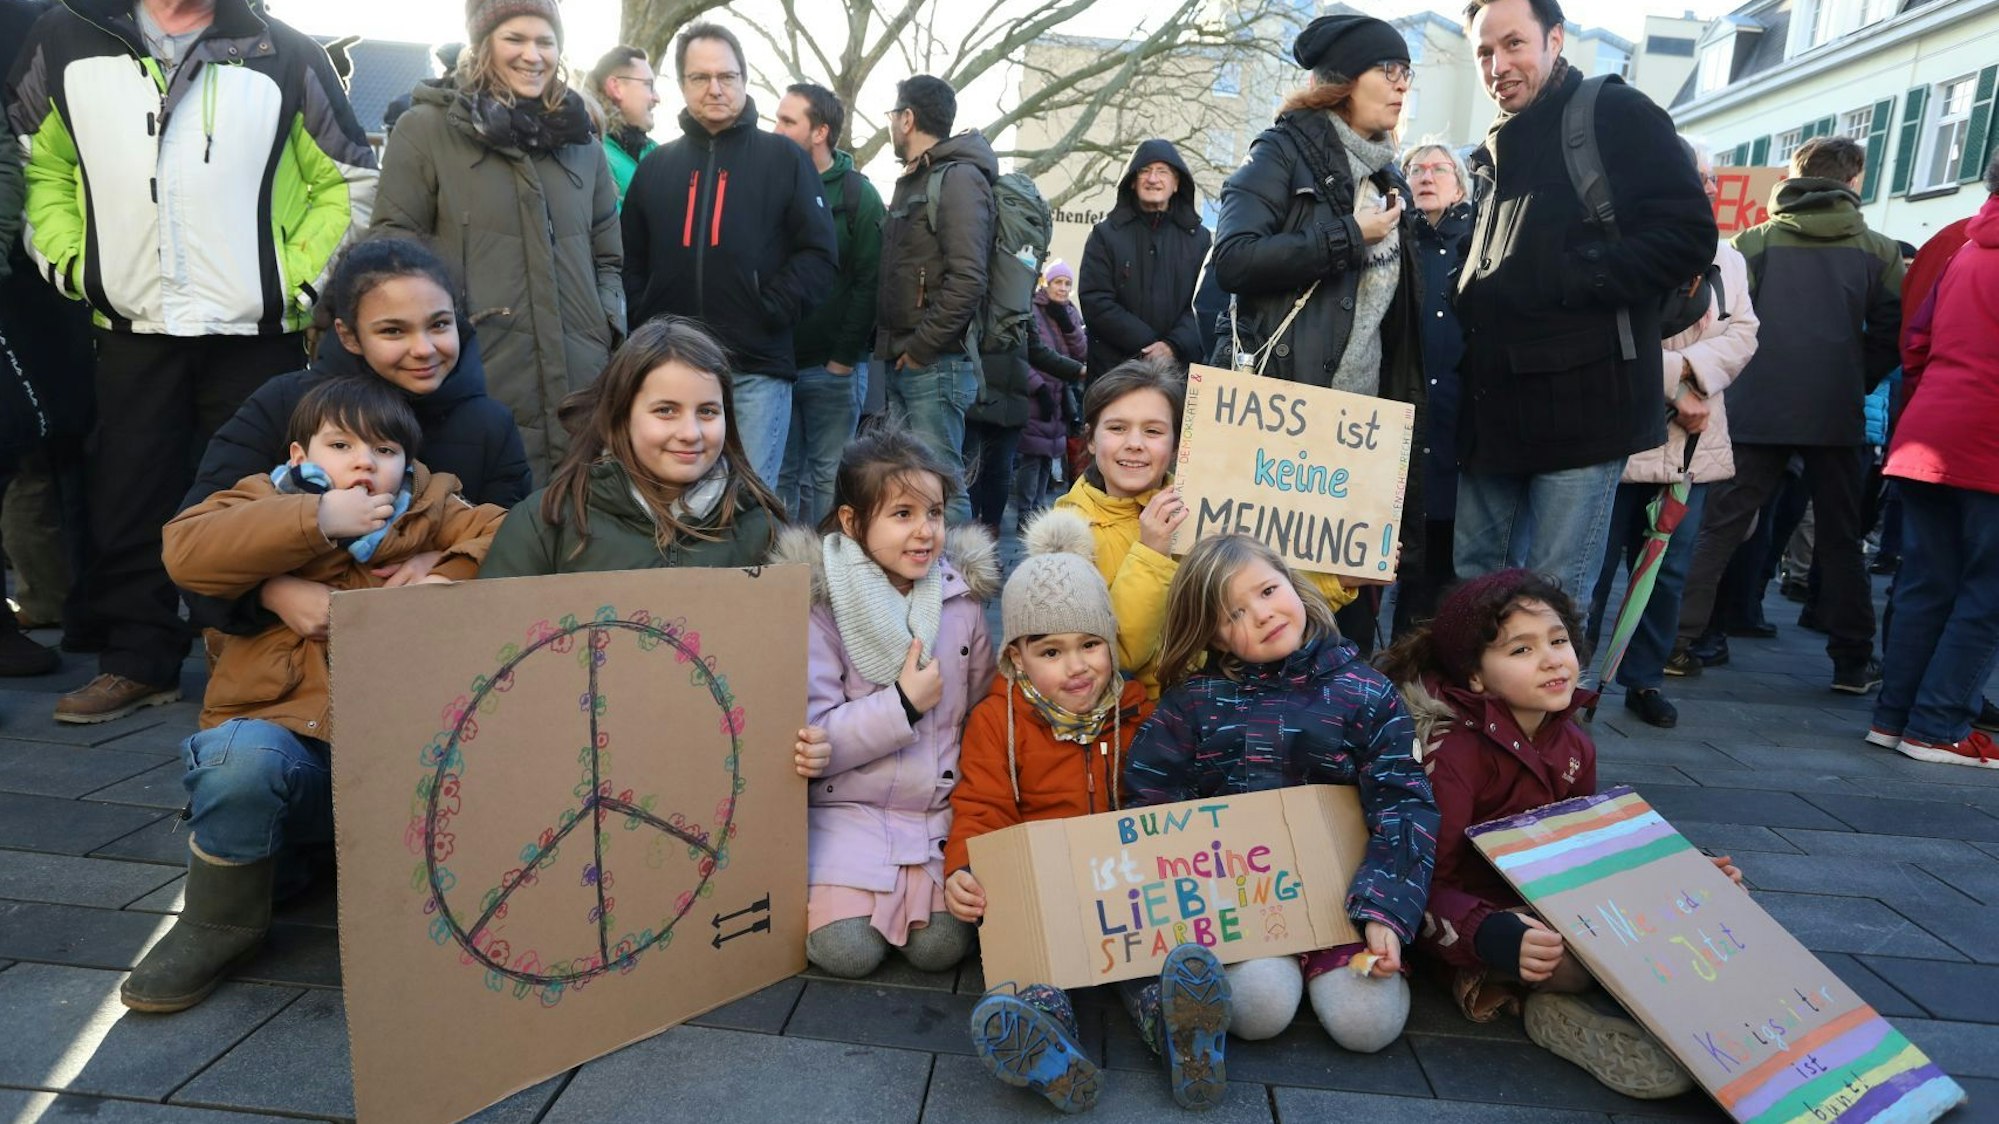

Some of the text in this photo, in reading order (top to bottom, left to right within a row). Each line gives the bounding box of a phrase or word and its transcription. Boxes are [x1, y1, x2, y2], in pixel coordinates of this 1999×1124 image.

[1214, 385, 1381, 450] HASS ist
[1254, 448, 1350, 498] keine
[1117, 804, 1230, 845] BUNT
[1091, 840, 1271, 891] ist meine
[1790, 1053, 1828, 1079] ist
[1803, 1070, 1870, 1121] bunt!
